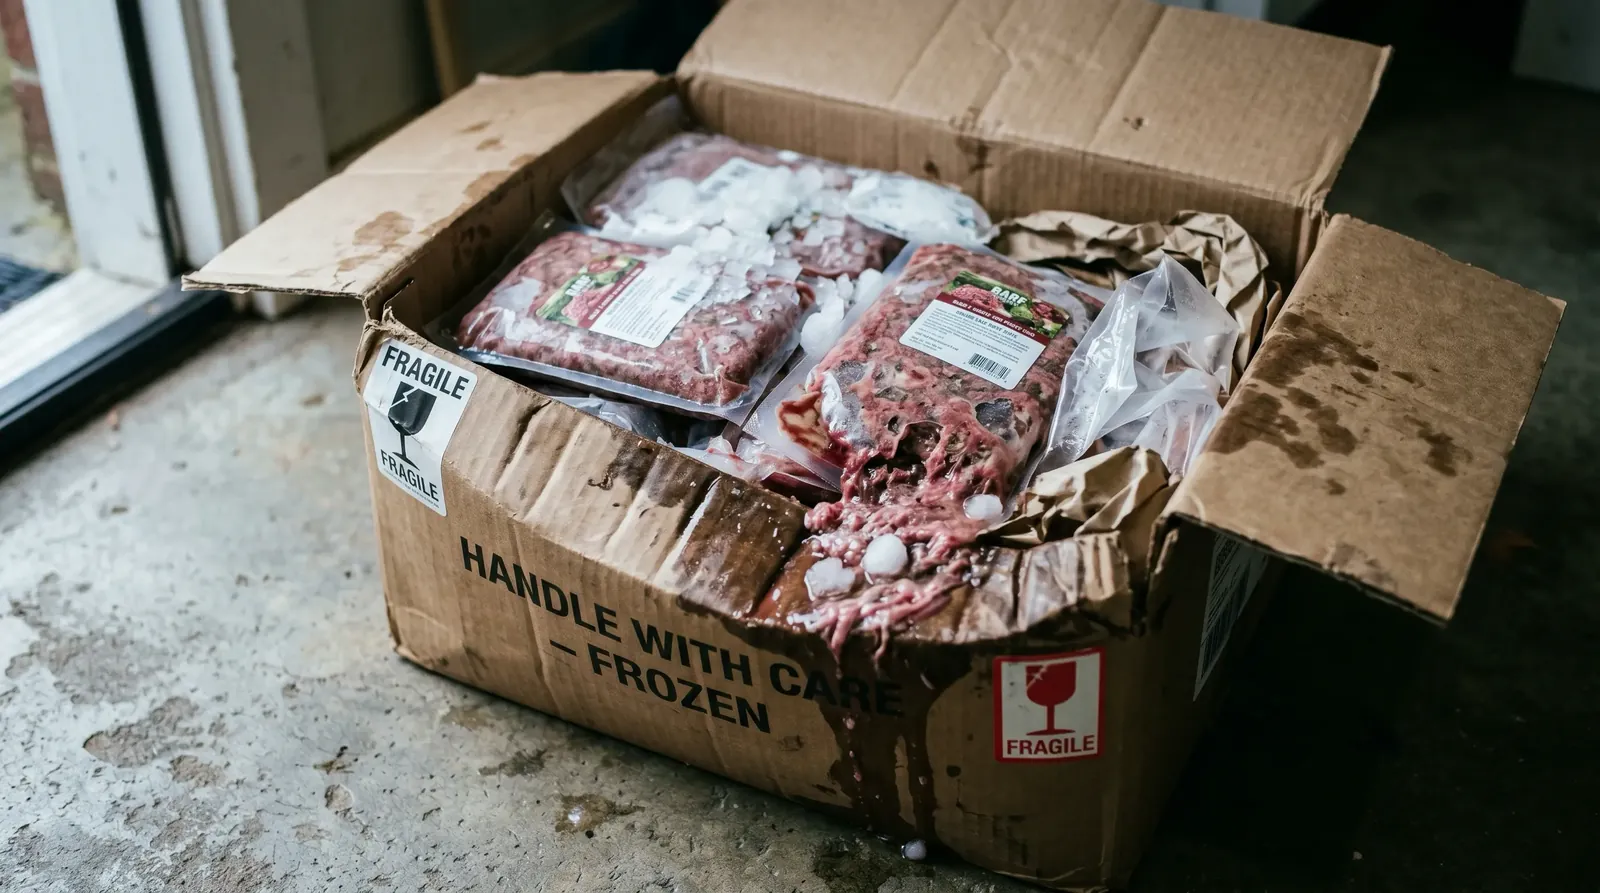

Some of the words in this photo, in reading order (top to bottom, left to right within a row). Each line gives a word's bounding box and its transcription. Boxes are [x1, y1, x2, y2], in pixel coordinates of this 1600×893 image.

[990, 286, 1028, 306] BARF
[381, 345, 470, 400] FRAGILE
[380, 449, 440, 502] FRAGILE
[460, 536, 622, 643] HANDLE
[631, 617, 753, 686] WITH
[769, 662, 904, 716] CARE
[587, 643, 772, 734] FROZEN
[1006, 734, 1095, 755] FRAGILE
